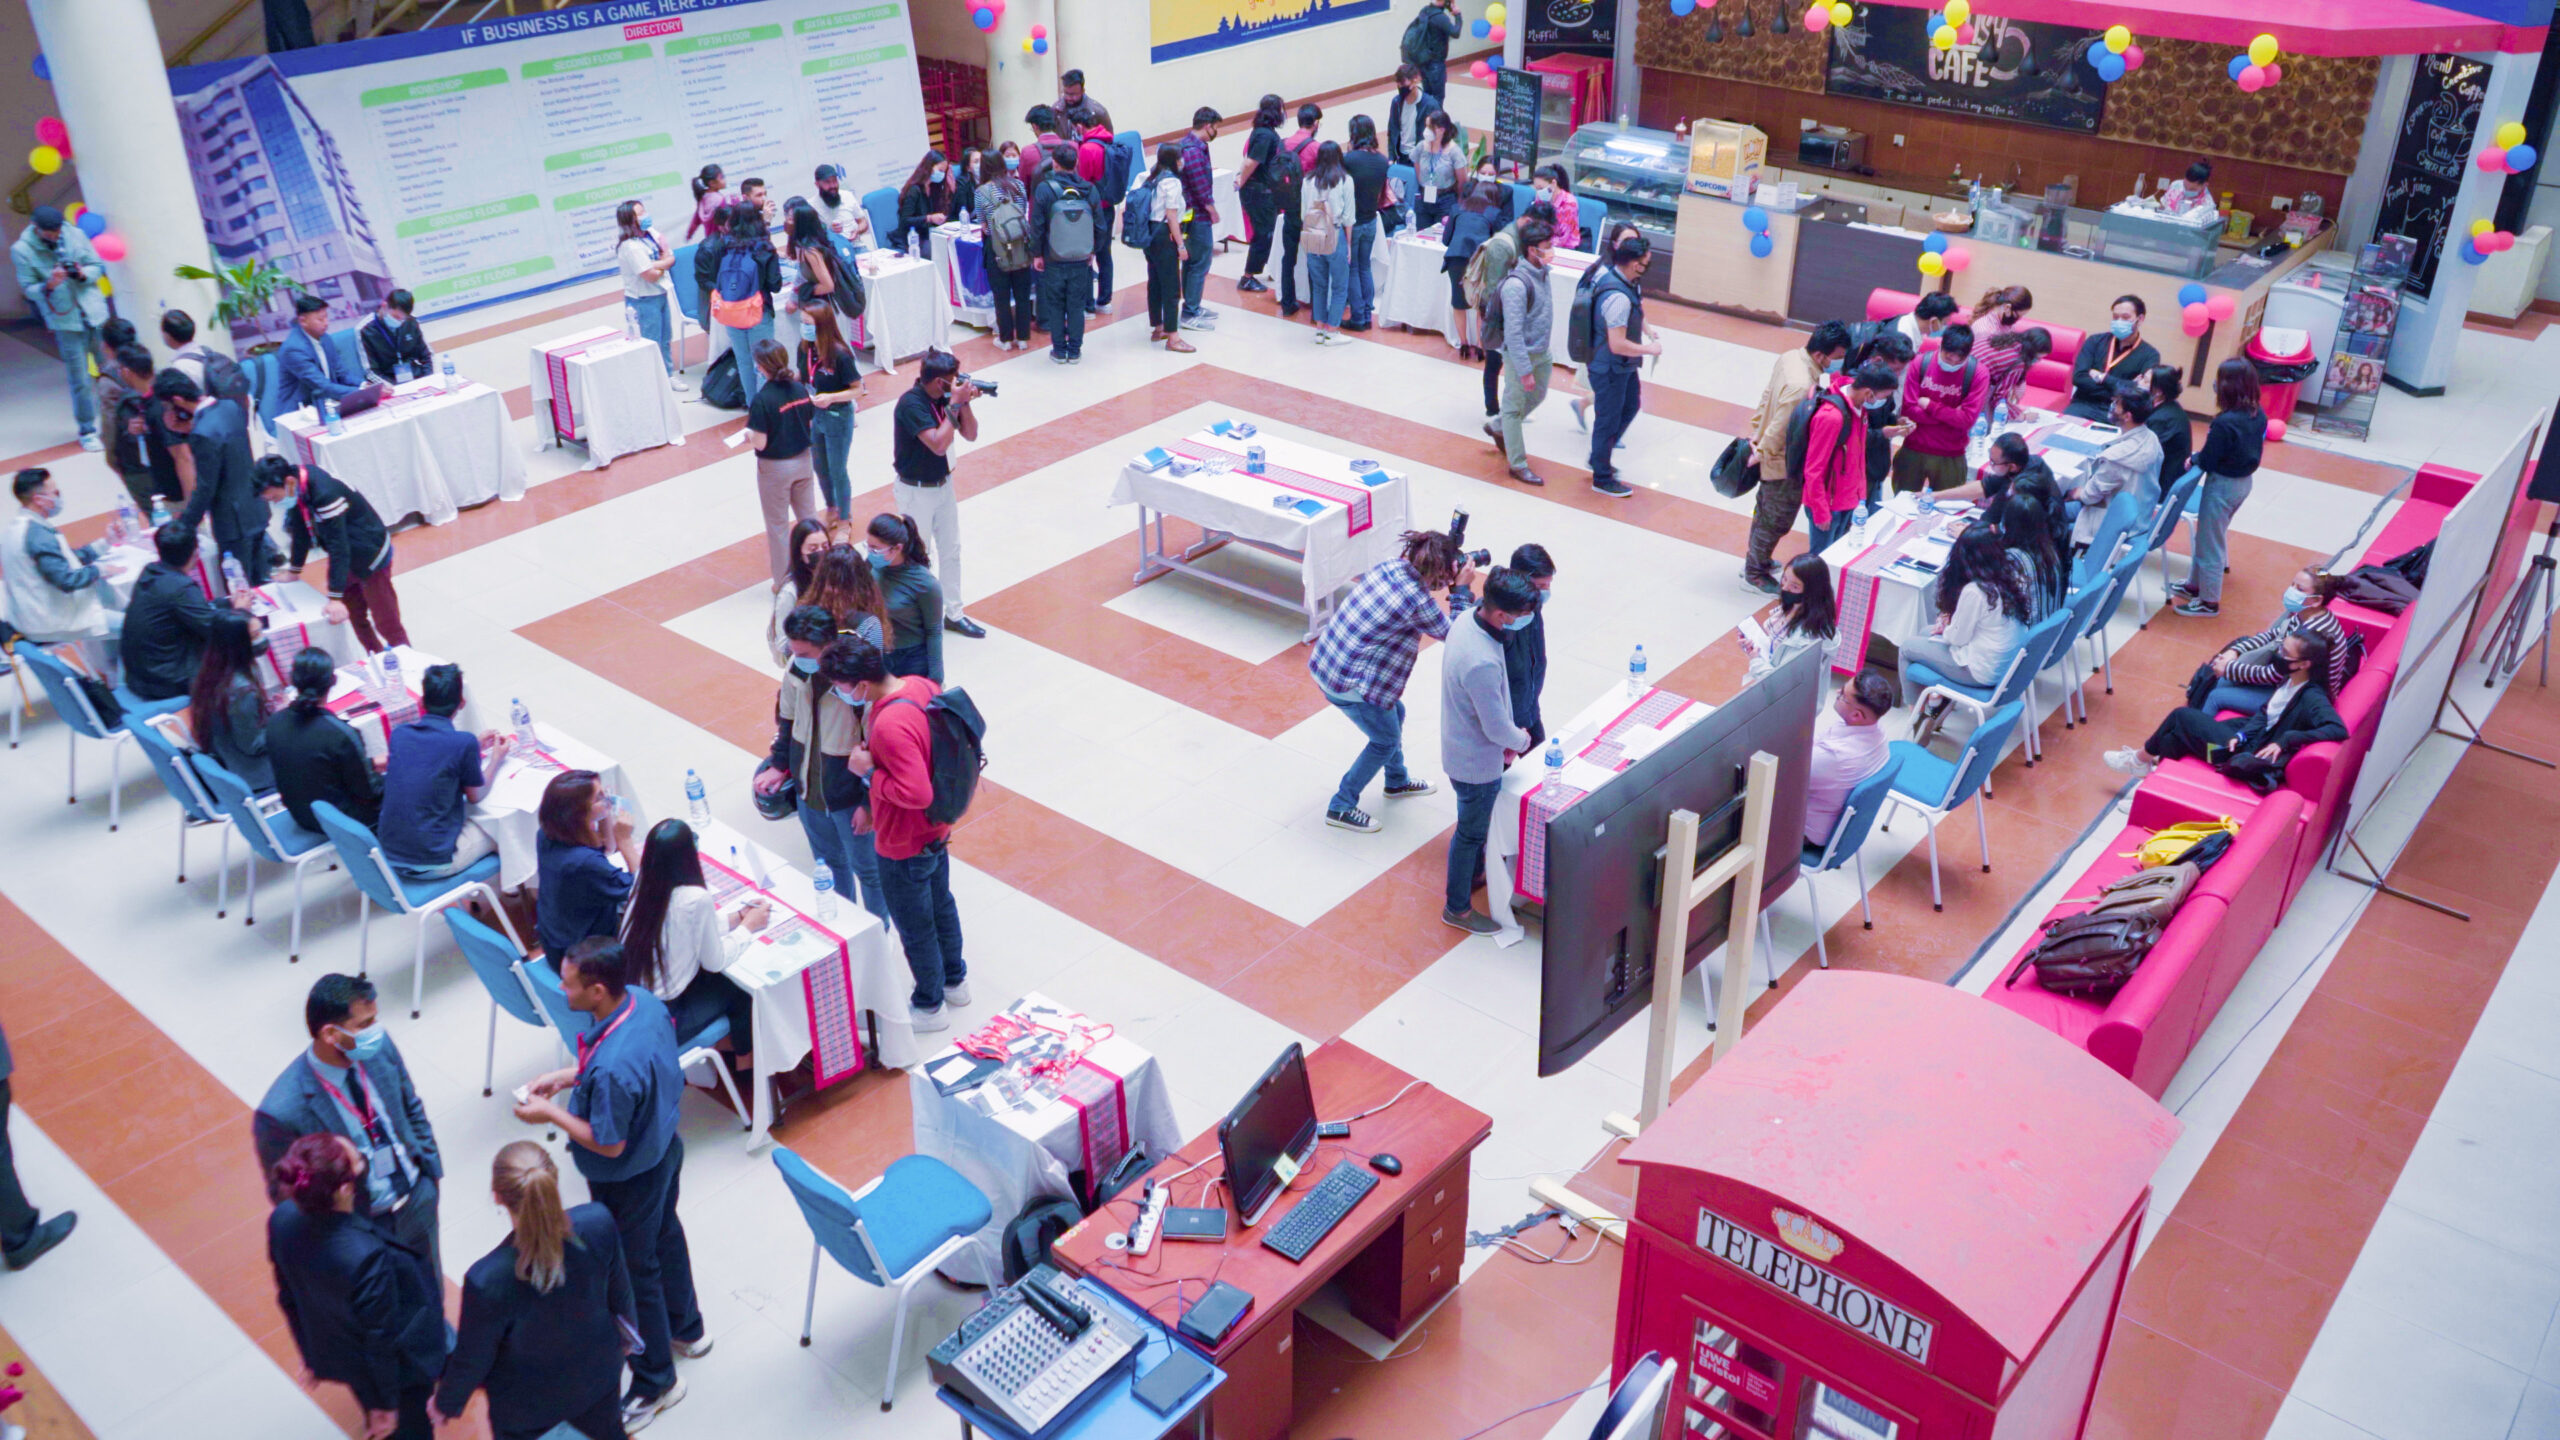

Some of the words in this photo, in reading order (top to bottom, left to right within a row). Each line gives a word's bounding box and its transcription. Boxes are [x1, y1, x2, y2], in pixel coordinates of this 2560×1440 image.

[461, 28, 477, 45] IF
[482, 14, 570, 41] BUSINESS
[572, 11, 590, 27] IS
[594, 9, 605, 24] A
[607, 1, 656, 21] GAME,
[625, 19, 681, 39] DIRECTORY
[1929, 47, 1989, 87] CAFE
[1694, 180, 1727, 193] POPCORN
[475, 203, 507, 218] FLOOR
[485, 268, 517, 282] FLOOR
[1702, 1211, 1926, 1360] TELEPHONE
[1699, 1346, 1731, 1370] UWE
[1698, 1356, 1741, 1386] Bristol
